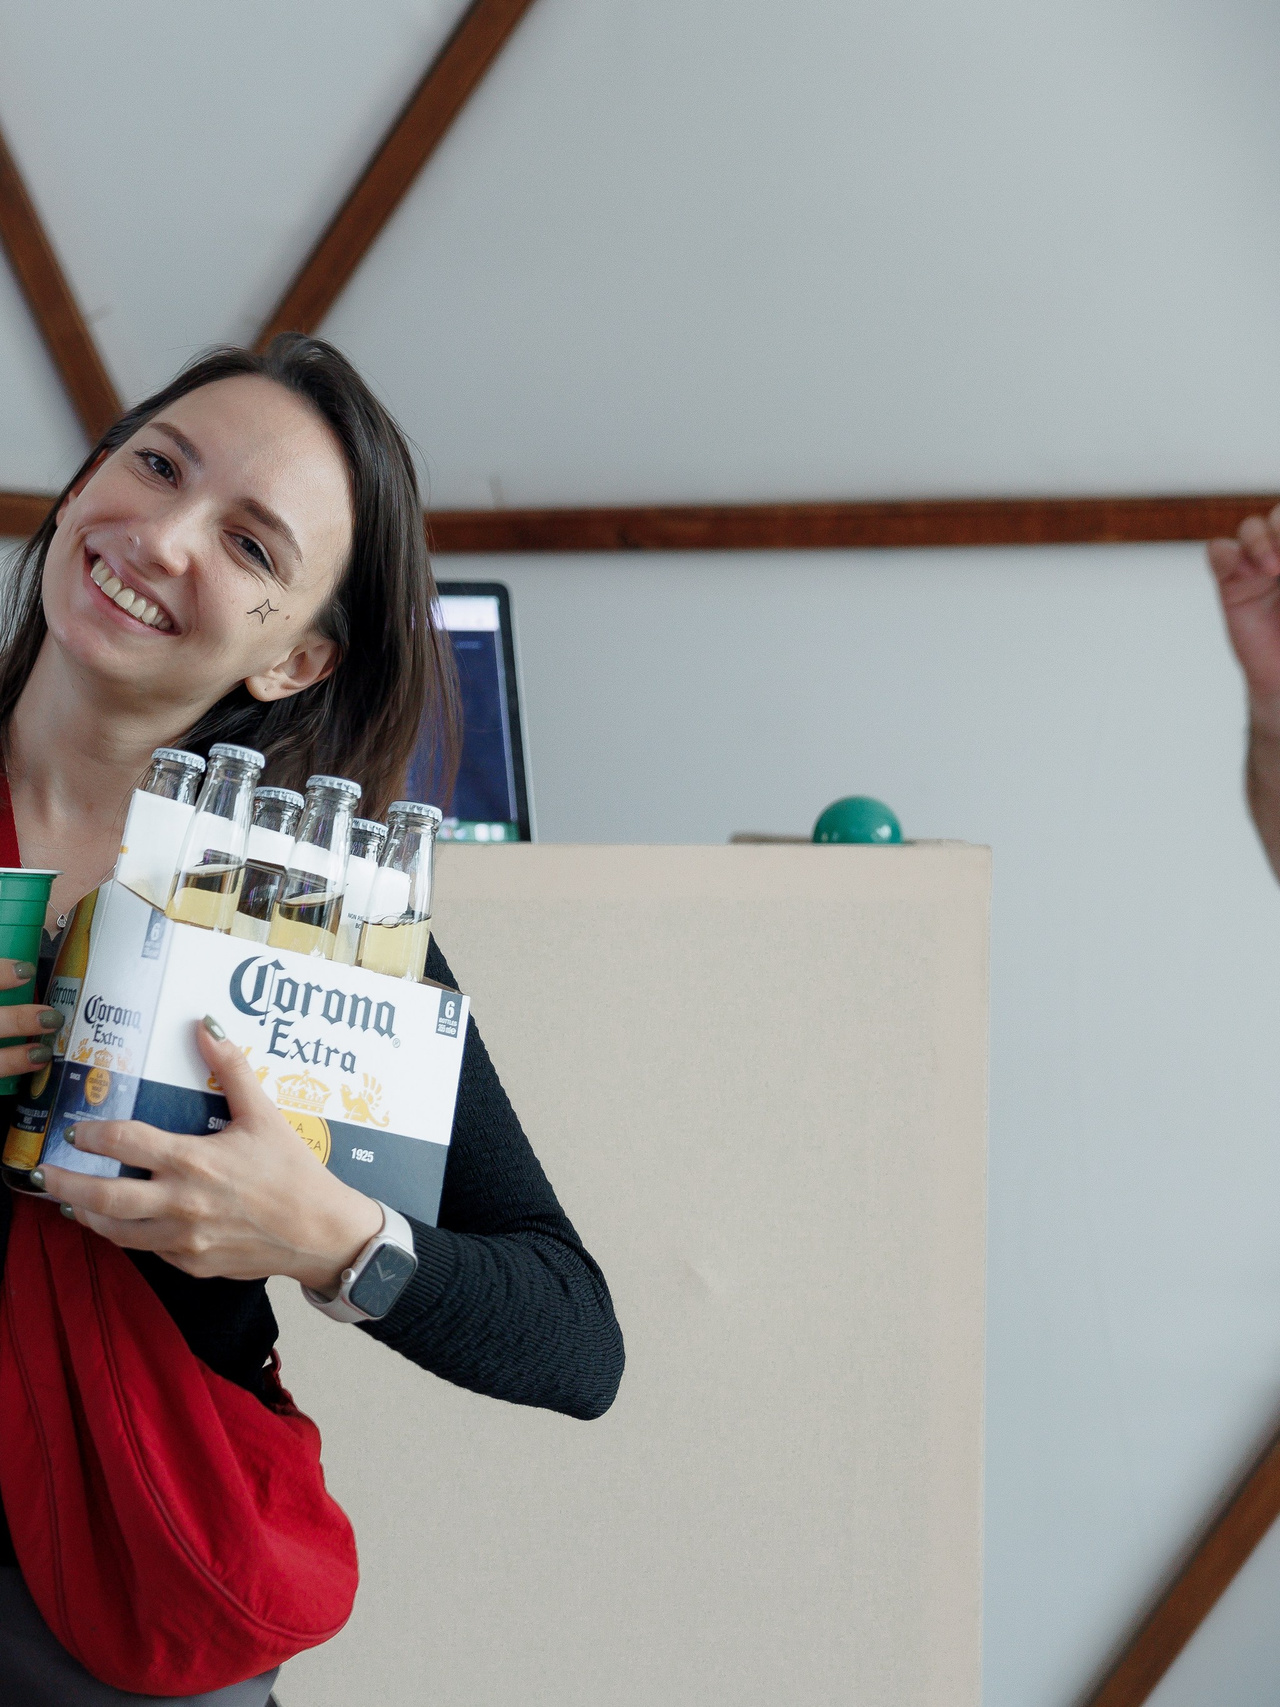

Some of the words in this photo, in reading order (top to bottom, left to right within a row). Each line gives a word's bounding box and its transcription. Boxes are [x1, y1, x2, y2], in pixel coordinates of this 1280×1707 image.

[84, 994, 141, 1029] Corona
[229, 955, 396, 1039] Corona
[444, 1000, 455, 1019] 6
[93, 1023, 124, 1048] Extra
[267, 1017, 357, 1075] Extra
[351, 1147, 374, 1163] 1925
